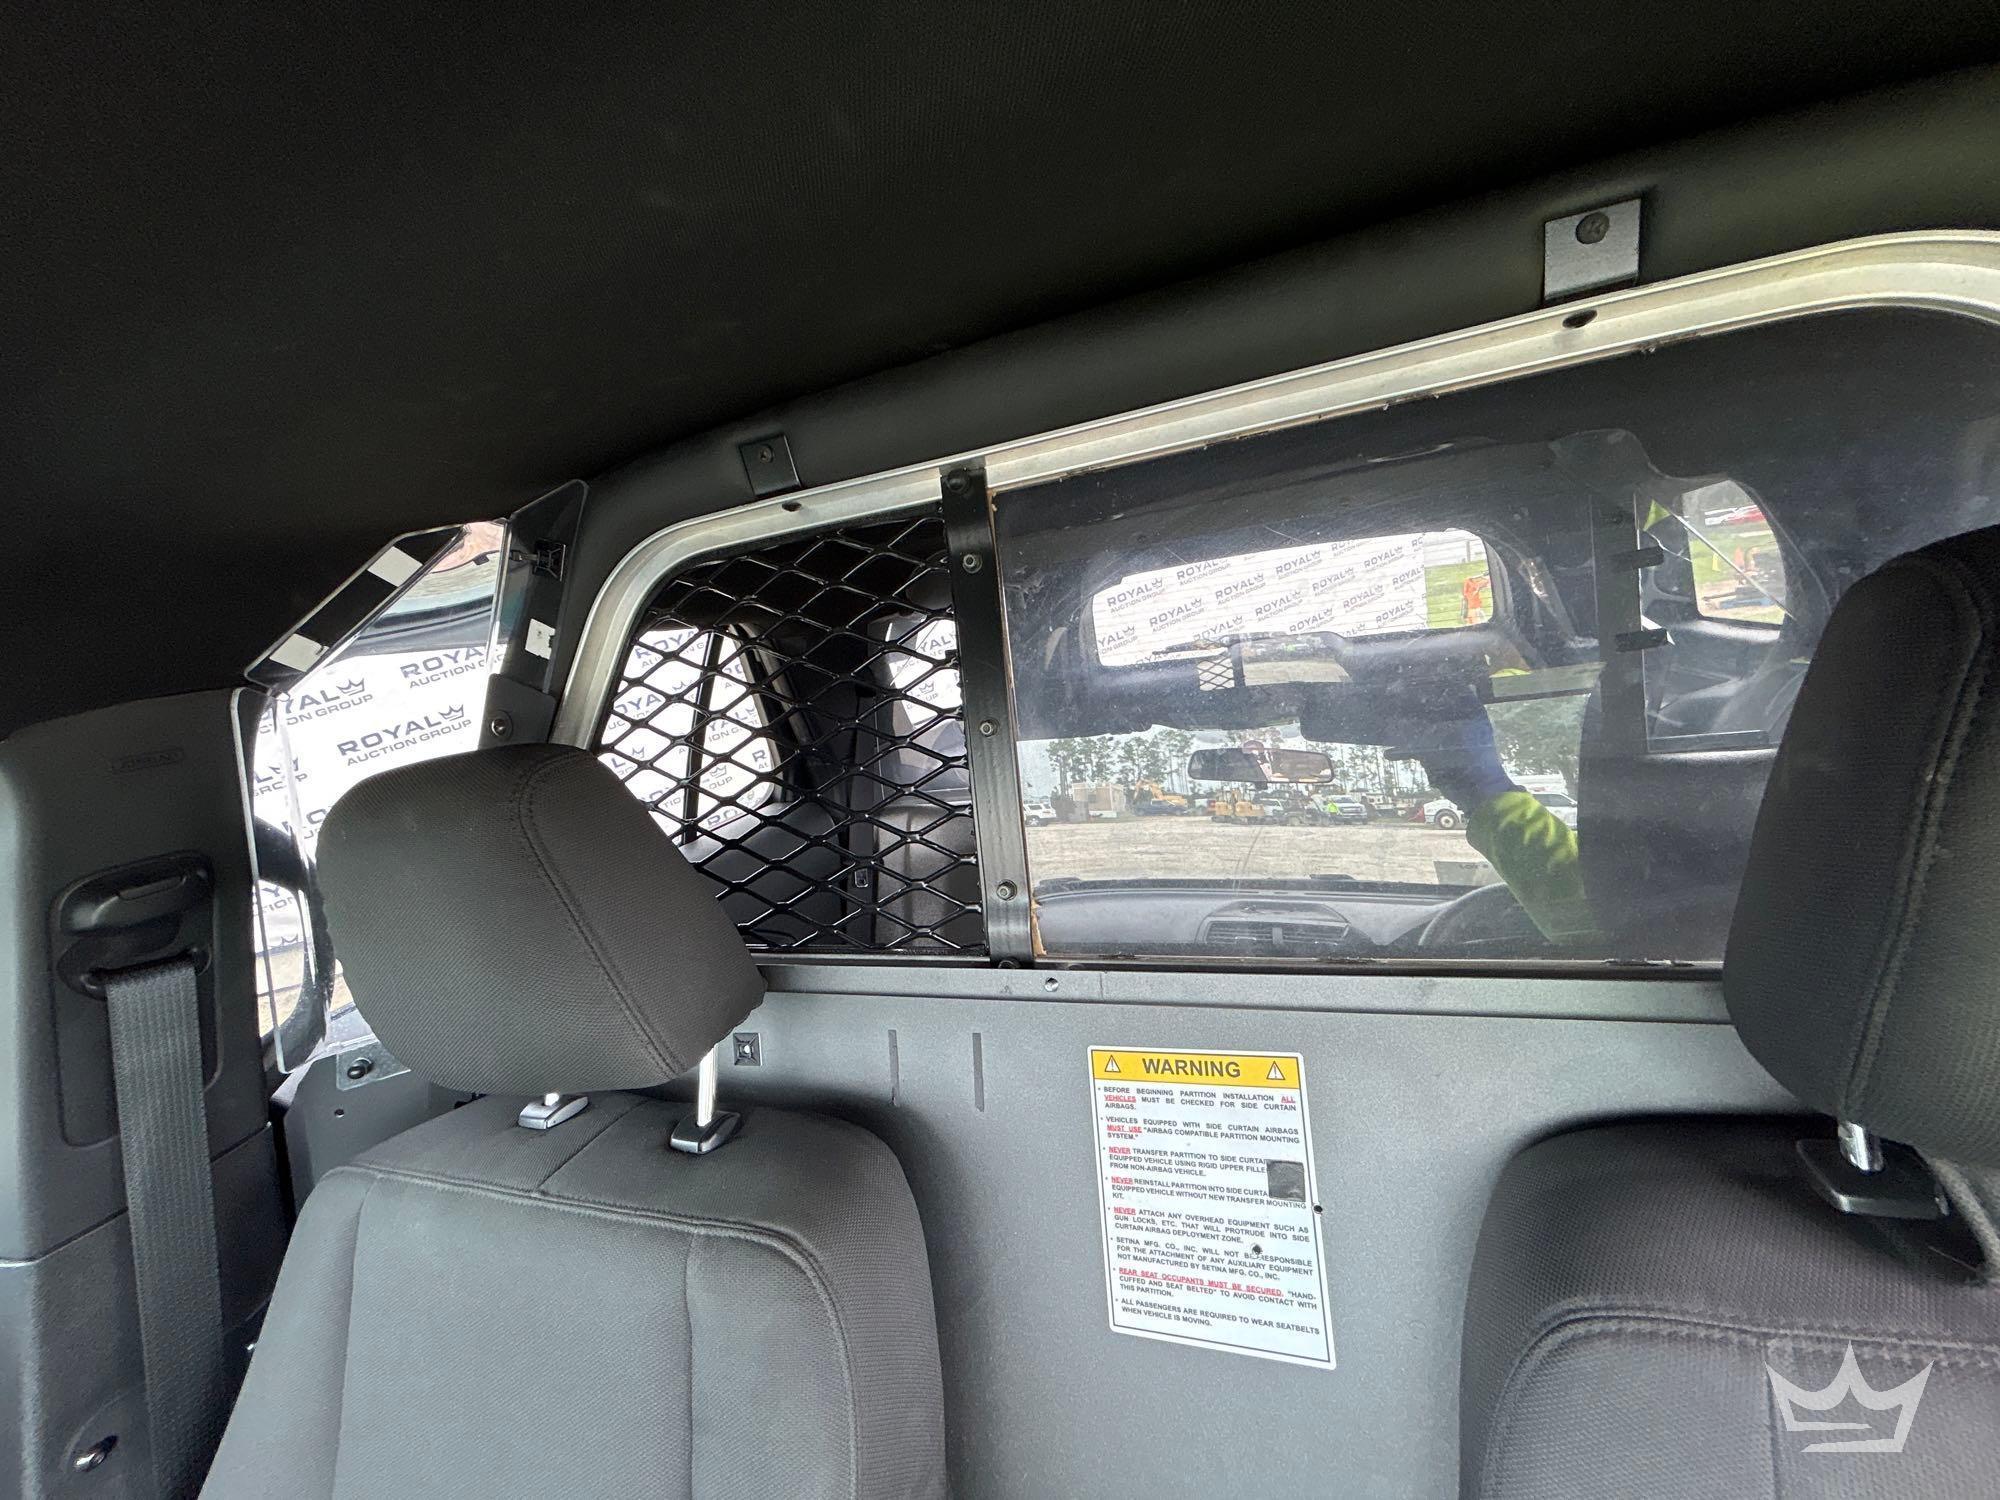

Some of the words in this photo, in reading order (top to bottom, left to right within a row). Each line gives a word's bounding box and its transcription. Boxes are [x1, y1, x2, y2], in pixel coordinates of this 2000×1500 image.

[1276, 554, 1312, 575] ROYAL
[1364, 549, 1395, 569] ROYAL
[1177, 560, 1219, 580] ROYAL
[1392, 567, 1421, 586] ROYAL
[1215, 578, 1255, 600] ROYAL
[1312, 571, 1346, 592] ROYAL
[1107, 584, 1152, 607] ROYAL
[1255, 594, 1292, 617] ROYAL
[1343, 588, 1375, 609] ROYAL
[1149, 604, 1192, 627] ROYAL
[1289, 612, 1325, 633] ROYAL
[1376, 604, 1405, 623] ROYAL
[1097, 632, 1124, 648] YAL
[400, 648, 484, 678] ROYA
[410, 662, 476, 688] AUCTION
[315, 694, 373, 718] GROUP
[336, 715, 442, 756] ROYAL
[347, 737, 418, 766] AUCTION
[419, 719, 472, 741] GROUP
[1143, 1059, 1241, 1078] WARNING
[1104, 1094, 1137, 1102] VEHICLES
[1180, 1099, 1215, 1107] CHECKED
[1264, 1104, 1297, 1112] CURTAIN
[1136, 1088, 1174, 1096] BEGINNING
[1223, 1093, 1275, 1102] INSTALLATION
[1106, 1116, 1138, 1124] VEHICLES
[1143, 1119, 1178, 1127] EQUIPPED
[1228, 1125, 1260, 1133] CURTAIN
[1263, 1127, 1299, 1135] AIRBAGS
[1175, 1129, 1219, 1138] COMPATIBLE
[1220, 1132, 1258, 1141] PARTITION
[1260, 1135, 1300, 1144] MOUNTING
[1109, 1146, 1131, 1154] NEVER
[1133, 1148, 1168, 1157] TRANSFER
[1170, 1151, 1206, 1160] PARTITION
[1239, 1157, 1266, 1165] CURTAI
[1109, 1154, 1143, 1163] EQUIPPED
[1144, 1157, 1173, 1165] VEHICLE
[1175, 1160, 1197, 1168] USING
[1220, 1164, 1244, 1172] UPPER
[1246, 1166, 1267, 1174] FILLE
[1130, 1164, 1173, 1174] NON-AIRBAG
[1111, 1176, 1133, 1184] NEVER
[1134, 1179, 1170, 1188] REINSTALL
[1171, 1182, 1207, 1191] PARTITION
[1243, 1189, 1269, 1197] CURTA
[1112, 1184, 1145, 1193] EQUIPPED
[1145, 1188, 1175, 1196] VEHICLE
[1176, 1191, 1208, 1200] WITHOUT
[1226, 1196, 1265, 1205] TRANSFER
[1266, 1200, 1307, 1210] MOUNTING
[1139, 1209, 1165, 1218] ATTACH
[1185, 1215, 1225, 1224] OVERHEAD
[1228, 1219, 1271, 1229] EQUIPMENT
[1274, 1224, 1295, 1232] SUCH
[1115, 1223, 1144, 1231] CURTAIN
[1145, 1226, 1171, 1235] AIRBAG
[1173, 1230, 1221, 1241] DEPLOYMENT
[1181, 1222, 1199, 1230] THAT
[1225, 1227, 1265, 1238] PROTRUDE
[1270, 1232, 1288, 1240] INTO
[1292, 1235, 1310, 1243] SIDE
[1117, 1237, 1140, 1245] SETINA
[1224, 1250, 1240, 1258] NOT
[1133, 1255, 1189, 1268] MANUFACTURED
[1202, 1264, 1227, 1273] SETINA
[1149, 1249, 1195, 1260] ATTACHMENT
[1228, 1259, 1266, 1270] AUXILIARY
[1269, 1265, 1314, 1276] EQUIPMENT
[1119, 1268, 1137, 1276] REAR
[1162, 1274, 1204, 1285] OCCUPANTS
[1208, 1280, 1228, 1288] MUST
[1119, 1276, 1146, 1285] CUFFED
[1166, 1282, 1183, 1290] SEAT
[1233, 1292, 1256, 1301] AVOID
[1258, 1295, 1295, 1307] CONTACT
[1297, 1301, 1318, 1310] WITH
[1122, 1306, 1143, 1315] WHEN
[1144, 1310, 1172, 1320] VEHICLE
[1136, 1300, 1181, 1313] PASSENGERS
[1183, 1307, 1198, 1315] ARE
[1200, 1310, 1237, 1322] REQUIRED
[1239, 1316, 1249, 1324] TO
[1251, 1318, 1274, 1327] WEAR
[1275, 1322, 1320, 1335] SEATBELTS
